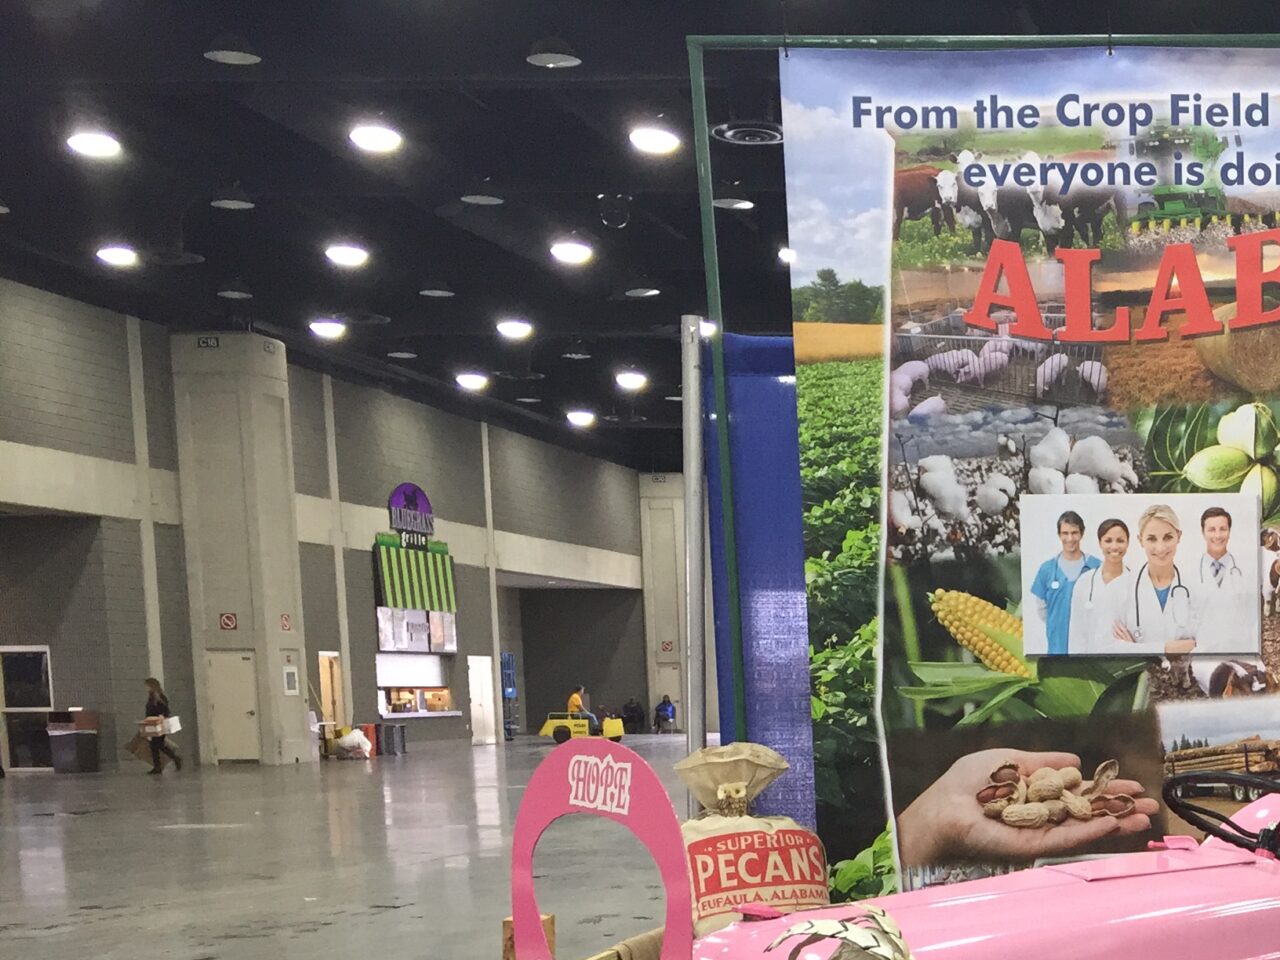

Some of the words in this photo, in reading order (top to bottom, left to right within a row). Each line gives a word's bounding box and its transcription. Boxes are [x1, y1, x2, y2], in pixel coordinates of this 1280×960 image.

[852, 96, 958, 129] From
[973, 95, 1040, 129] the
[1056, 94, 1153, 136] Crop
[1170, 92, 1270, 127] Field
[963, 163, 1158, 195] everyone
[1173, 153, 1205, 186] is
[401, 531, 426, 548] grille
[571, 758, 630, 809] HOPE
[716, 833, 804, 852] SUPERIOR
[694, 845, 824, 894] PECANS
